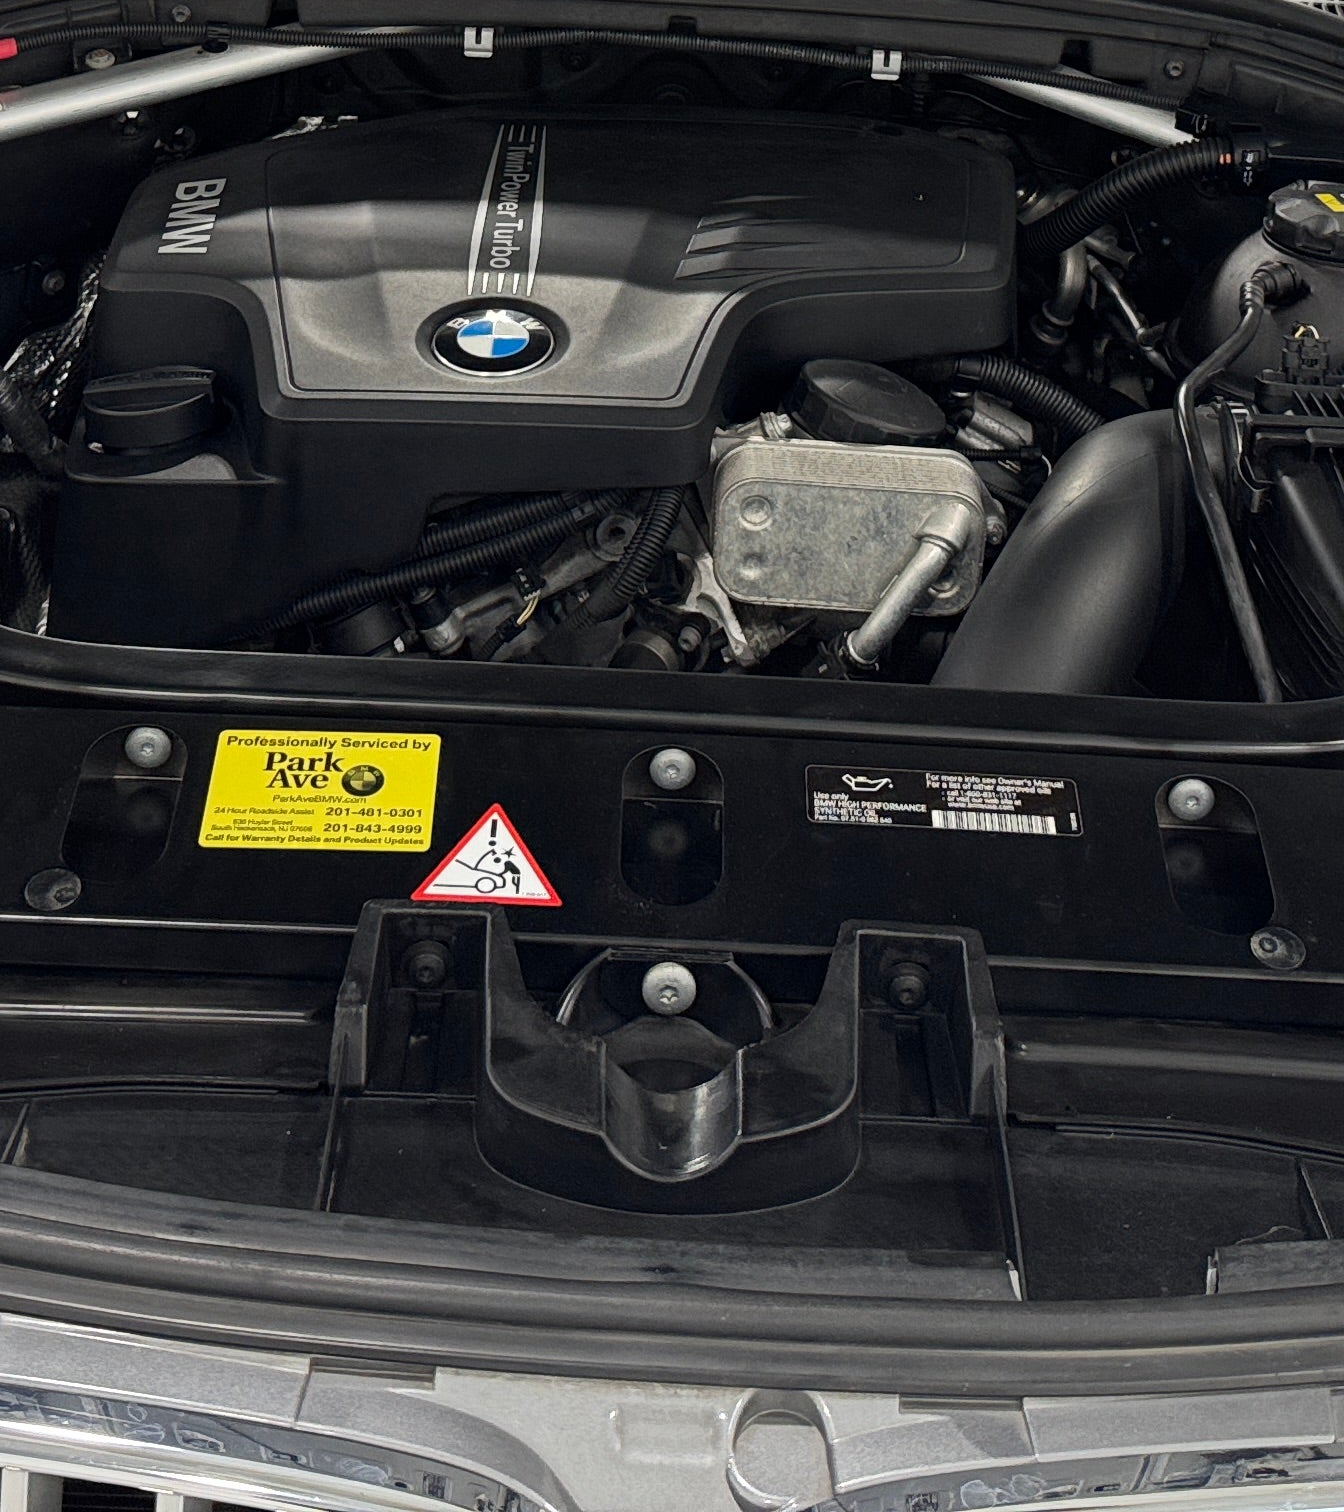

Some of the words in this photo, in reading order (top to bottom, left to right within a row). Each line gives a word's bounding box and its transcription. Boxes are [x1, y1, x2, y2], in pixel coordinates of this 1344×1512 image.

[496, 143, 535, 218] TwinPower
[158, 178, 226, 254] BMW
[489, 218, 524, 269] Turbo
[226, 735, 336, 750] Professionally
[340, 737, 408, 749] Serviced
[412, 739, 432, 751] by
[263, 751, 345, 772] Park
[265, 768, 329, 789] Ave
[272, 794, 367, 804] ParkAveBMW.com
[861, 801, 928, 813] PERFORMANCE
[325, 806, 423, 818] 201-481-0301
[323, 823, 423, 834] 201-843-4999
[205, 833, 225, 841] Call
[242, 834, 286, 843] Warranty
[288, 835, 321, 843] Details
[384, 837, 424, 846] Updates
